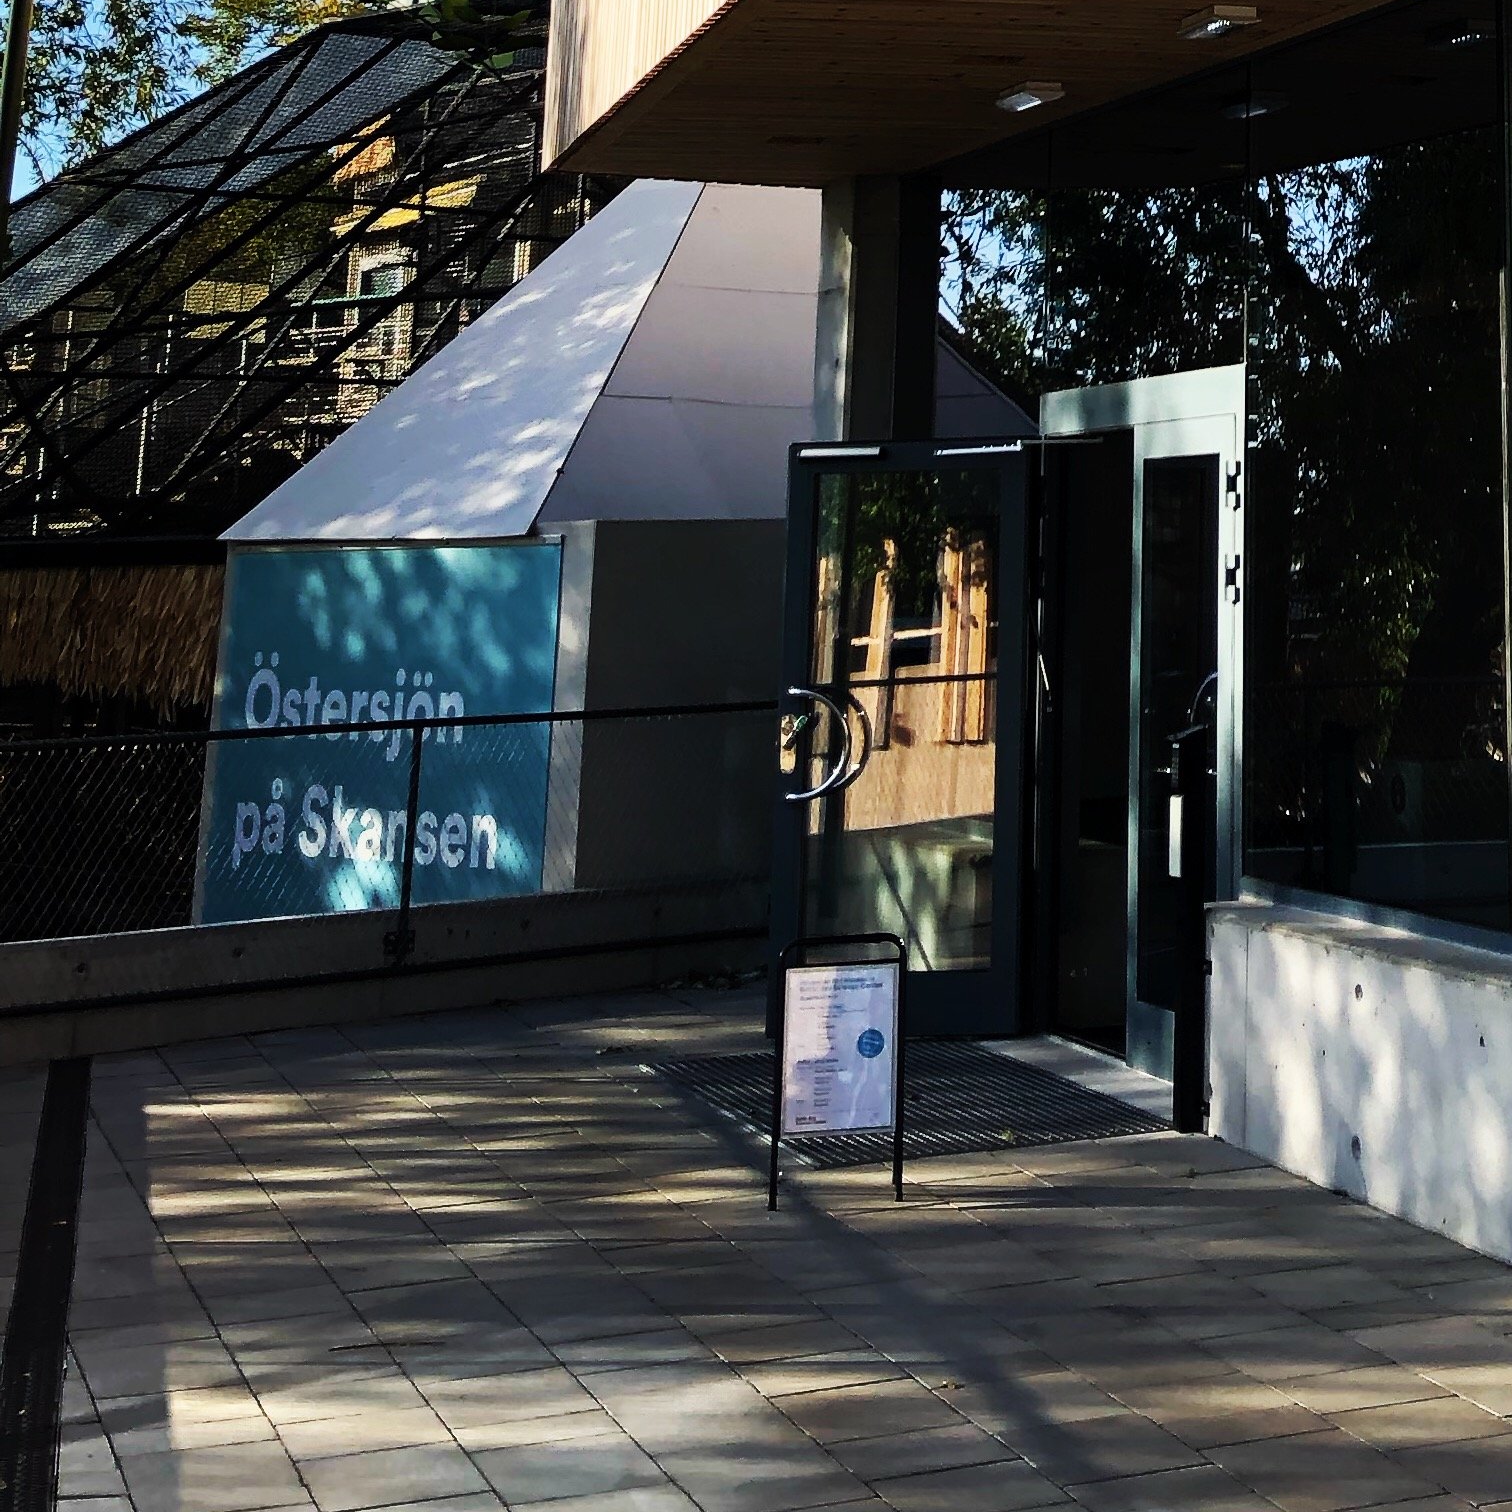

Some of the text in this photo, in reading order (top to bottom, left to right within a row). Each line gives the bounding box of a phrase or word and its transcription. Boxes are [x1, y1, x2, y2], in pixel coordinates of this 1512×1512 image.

[245, 651, 464, 762] Östersjön
[231, 778, 498, 869] på Skansen
